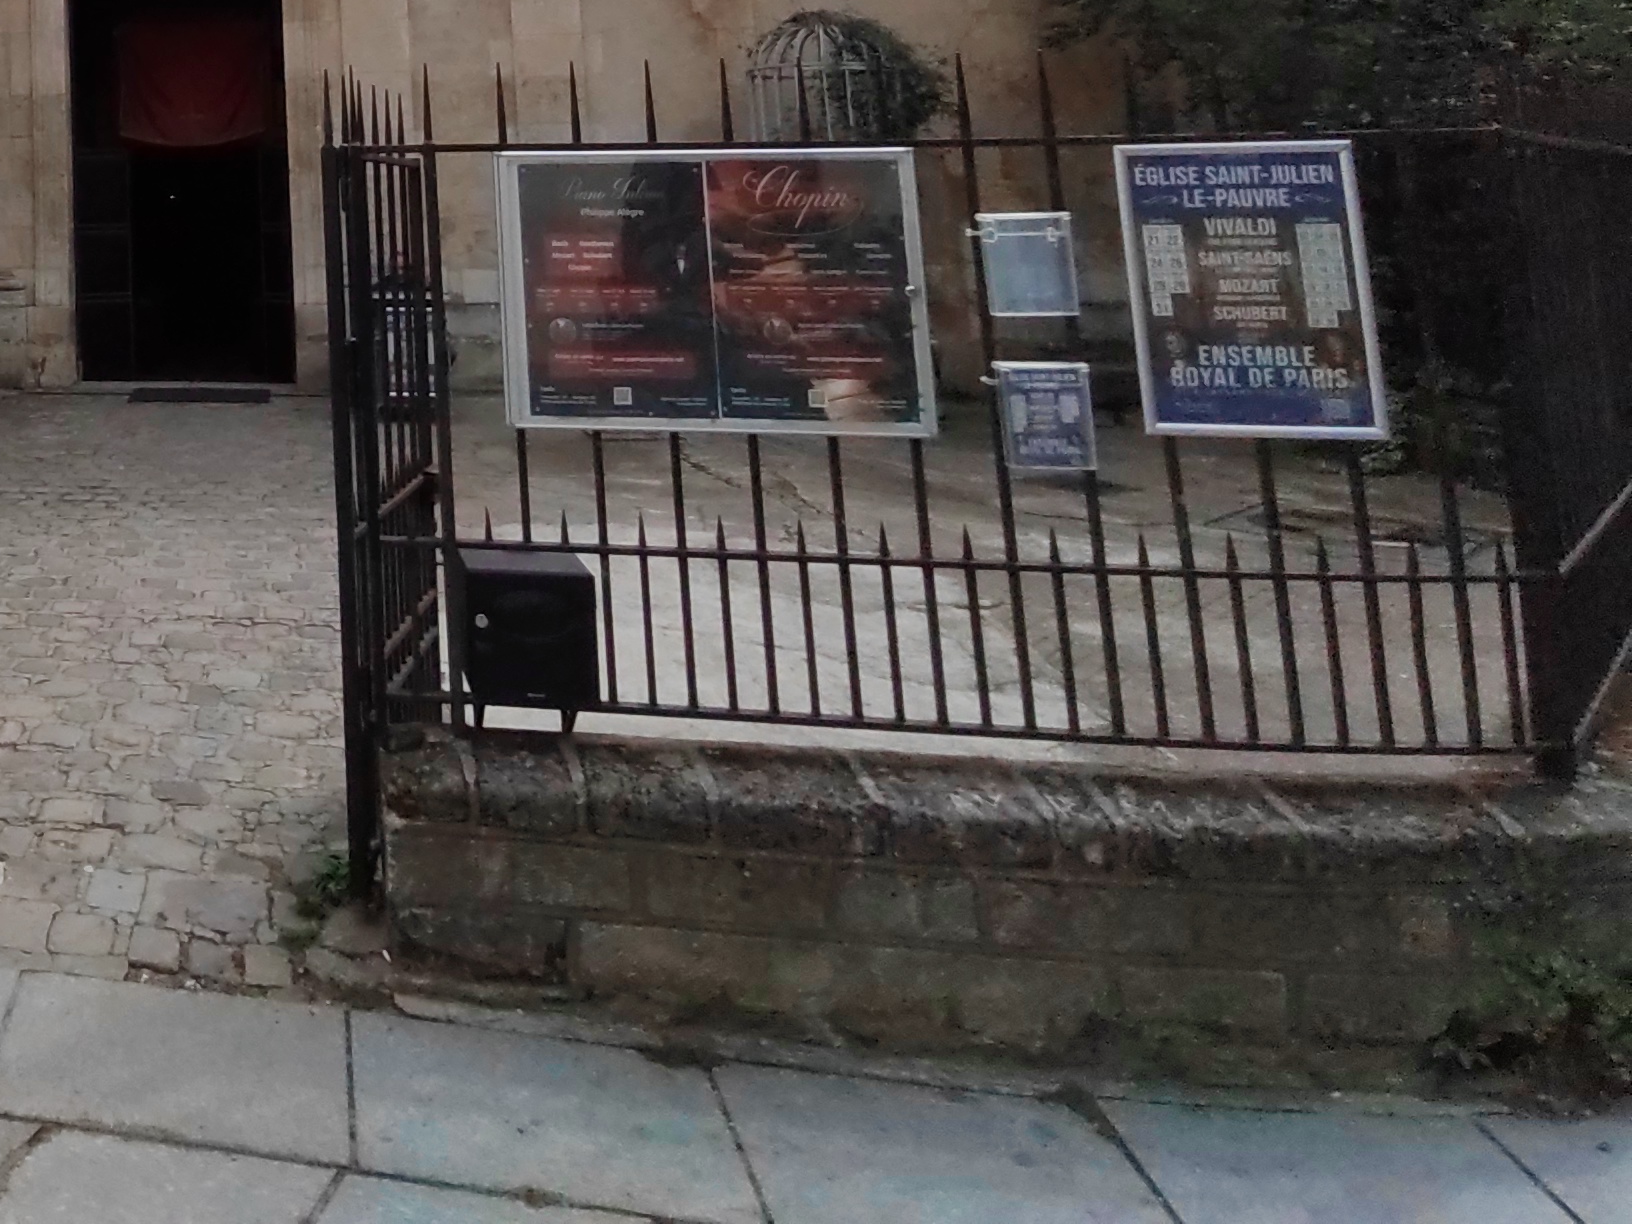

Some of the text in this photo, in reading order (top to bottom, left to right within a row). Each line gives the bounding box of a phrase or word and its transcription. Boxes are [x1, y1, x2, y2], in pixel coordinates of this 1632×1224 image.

[1134, 163, 1334, 186] ÉGLISE SAINT-JULIEN
[743, 165, 847, 228] Chopin
[1183, 187, 1291, 208] LE-PAUVRE
[1204, 217, 1277, 236] VIVALDI
[1219, 278, 1281, 293] MOZART
[1213, 306, 1287, 321] SCHUBERT
[1198, 345, 1315, 366] ENSEMBLE
[1170, 366, 1348, 388] ROYAL DE PARIS
